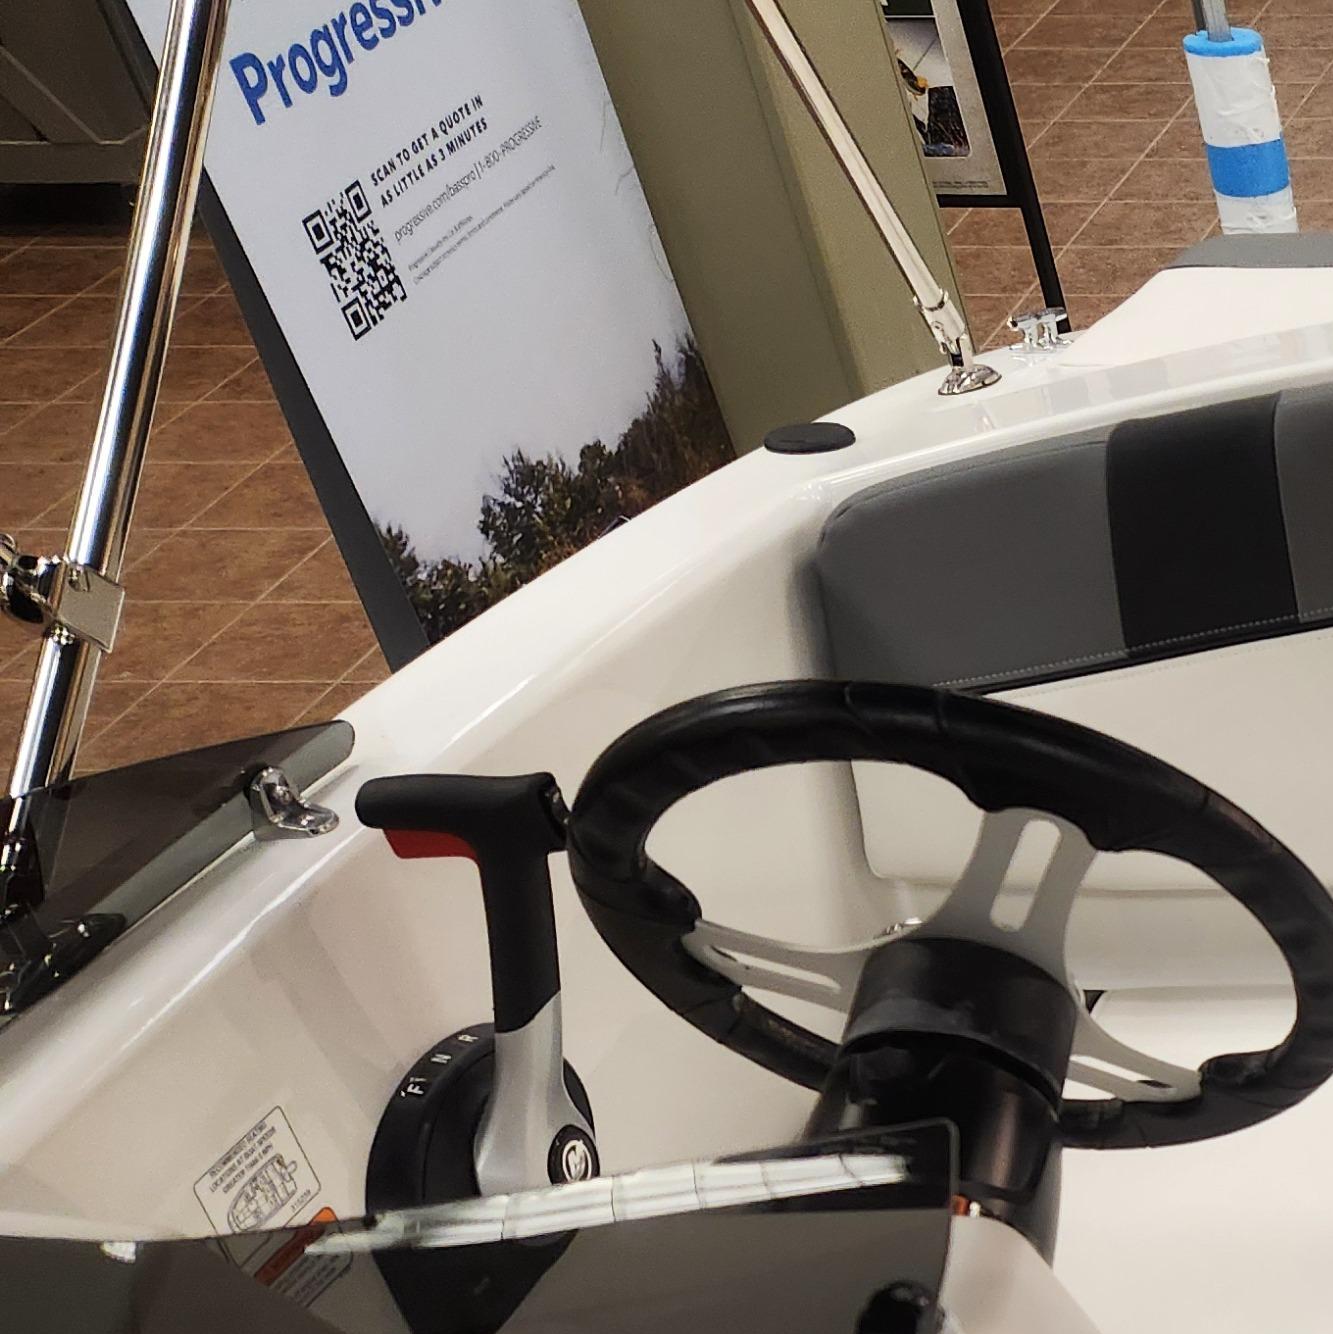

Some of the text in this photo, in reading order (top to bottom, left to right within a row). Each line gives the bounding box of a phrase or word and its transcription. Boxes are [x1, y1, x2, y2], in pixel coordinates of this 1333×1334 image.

[371, 95, 483, 186] SCAN TO GET A QUOTE IN
[381, 117, 487, 208] AS LITTLE AS 3 MINUTES
